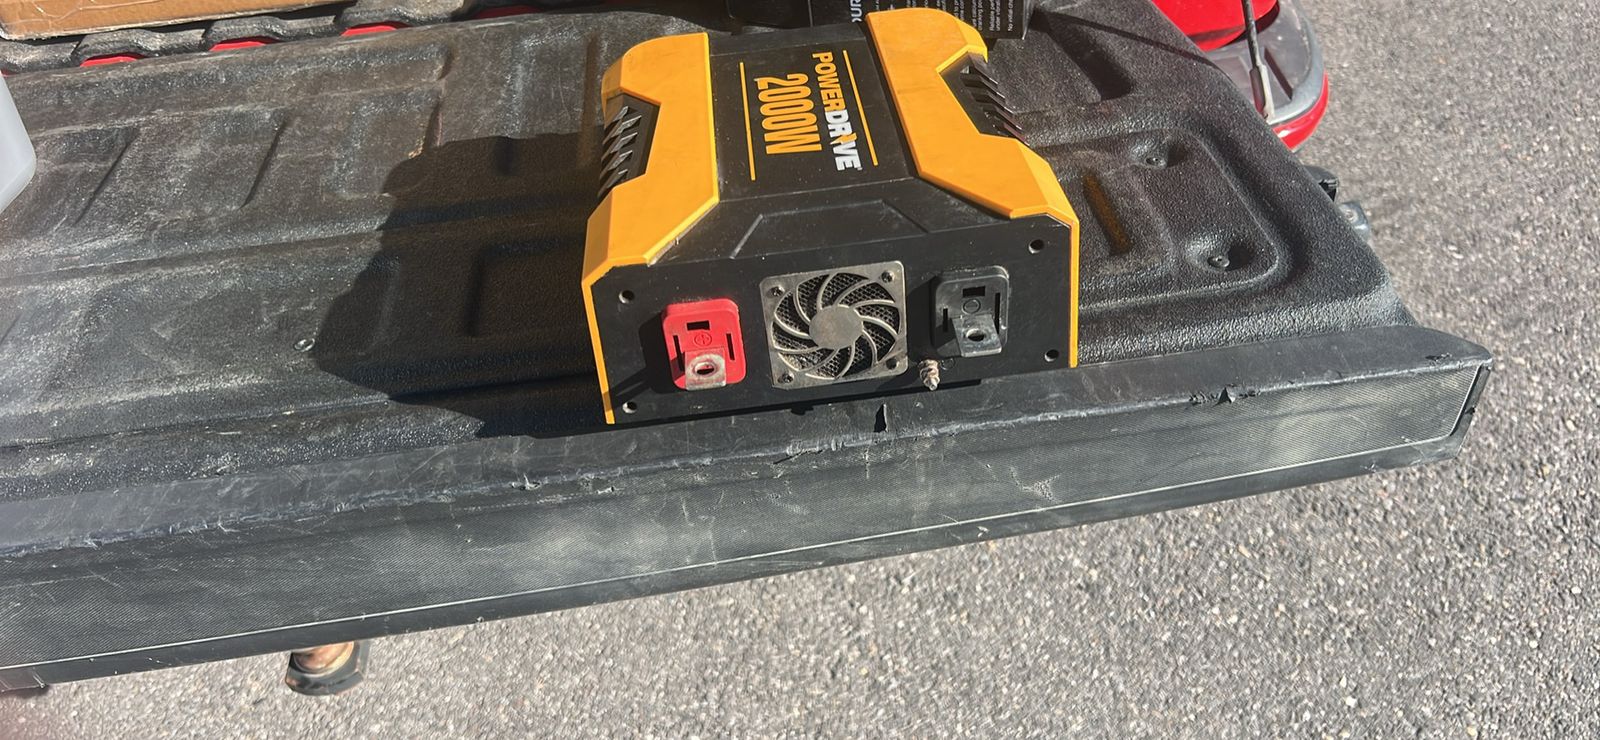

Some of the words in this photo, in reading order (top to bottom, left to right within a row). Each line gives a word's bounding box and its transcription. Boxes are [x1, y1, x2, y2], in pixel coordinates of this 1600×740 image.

[1008, 23, 1013, 32] No
[754, 73, 822, 154] 2000W
[812, 52, 862, 170] POWERDRIVE
